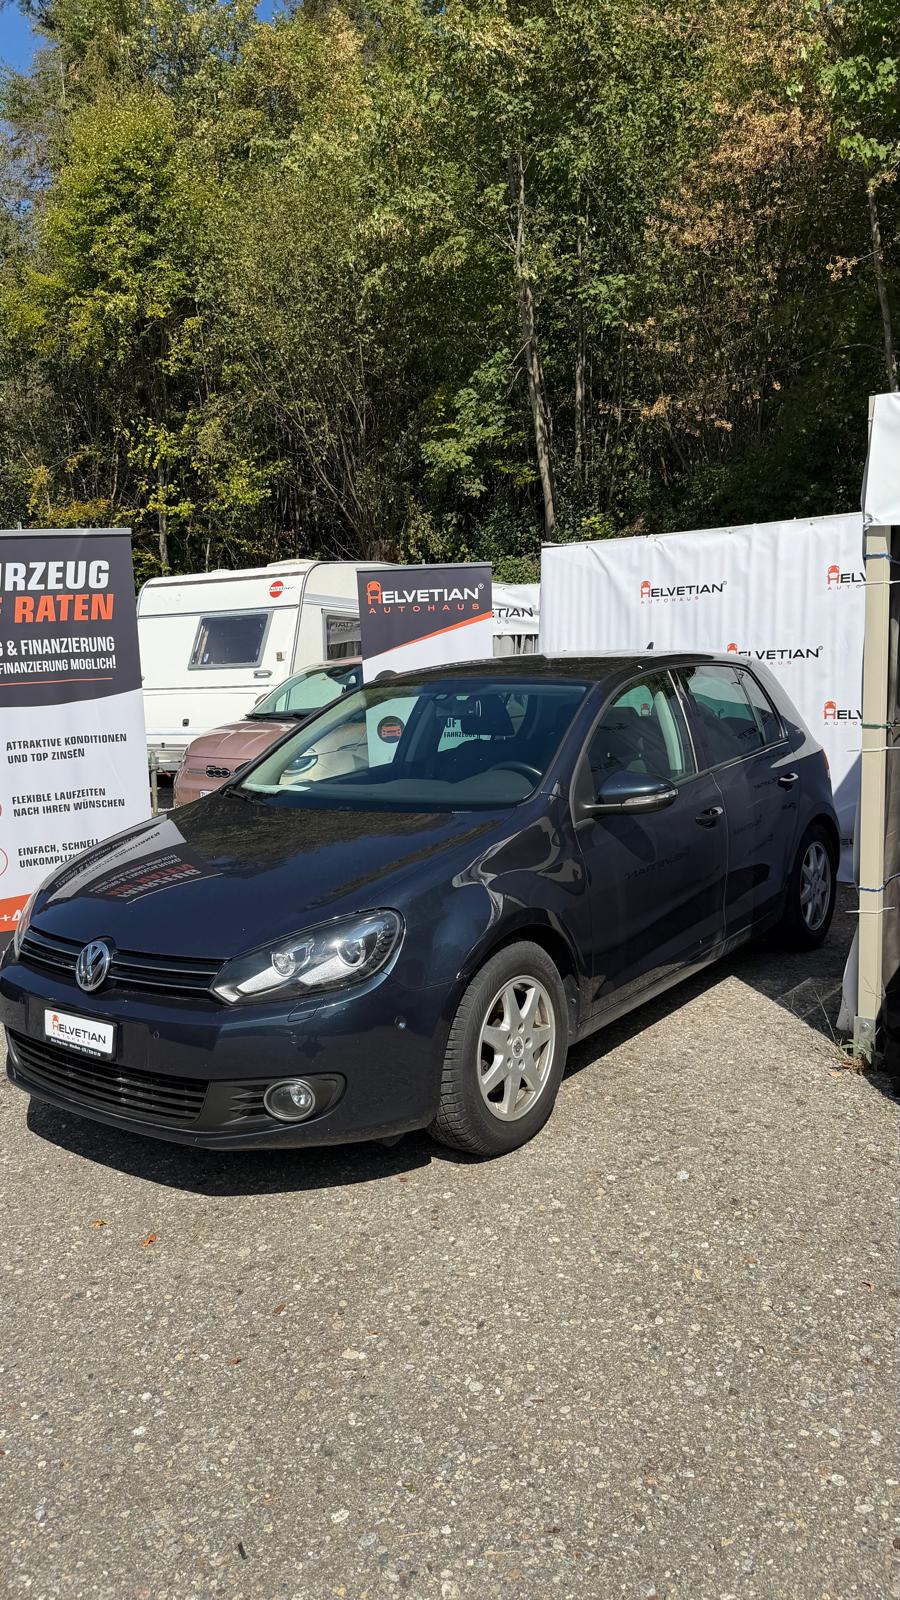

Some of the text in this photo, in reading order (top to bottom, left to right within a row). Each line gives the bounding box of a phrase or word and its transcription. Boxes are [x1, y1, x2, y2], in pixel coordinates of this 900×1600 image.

[0, 560, 110, 592] RZEUG
[14, 593, 114, 624] RATEN
[369, 603, 480, 615] AUTOHAUS
[492, 607, 533, 618] TIAN
[7, 640, 18, 656] &
[20, 636, 115, 656] FINANZIERUNG
[6, 733, 128, 751] ATTRAKTIVE KONDITIONEN
[8, 748, 85, 764] UND TOP ZINSEN
[12, 787, 106, 805] FLEXIBLE LAUFZEITEN
[13, 798, 125, 817] NACH IHREN WÜNSCHEN
[18, 844, 60, 856] EINFACH,
[20, 853, 77, 868] UNKOMPLIZ
[52, 1014, 106, 1044] HELVETIAN
